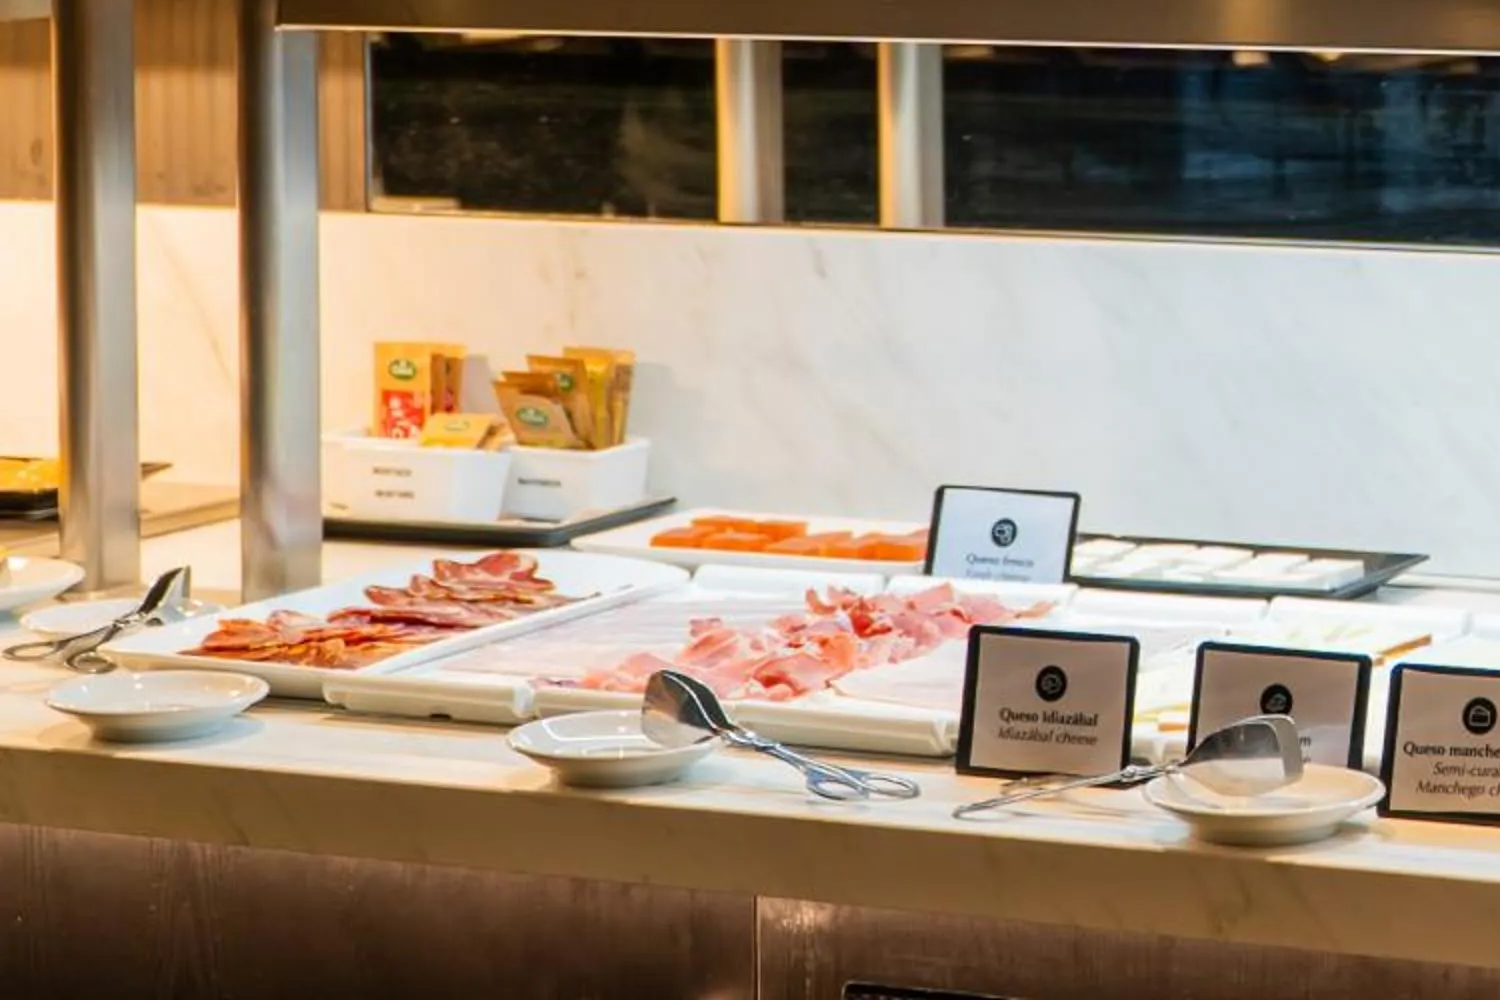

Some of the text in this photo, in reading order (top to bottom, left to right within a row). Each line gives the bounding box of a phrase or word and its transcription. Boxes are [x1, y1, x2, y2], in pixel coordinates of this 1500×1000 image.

[998, 707, 1098, 726] Queso Idiazábal
[1055, 729, 1098, 745] cheese
[1403, 741, 1446, 756] Queso
[1416, 779, 1486, 800] Manchego
